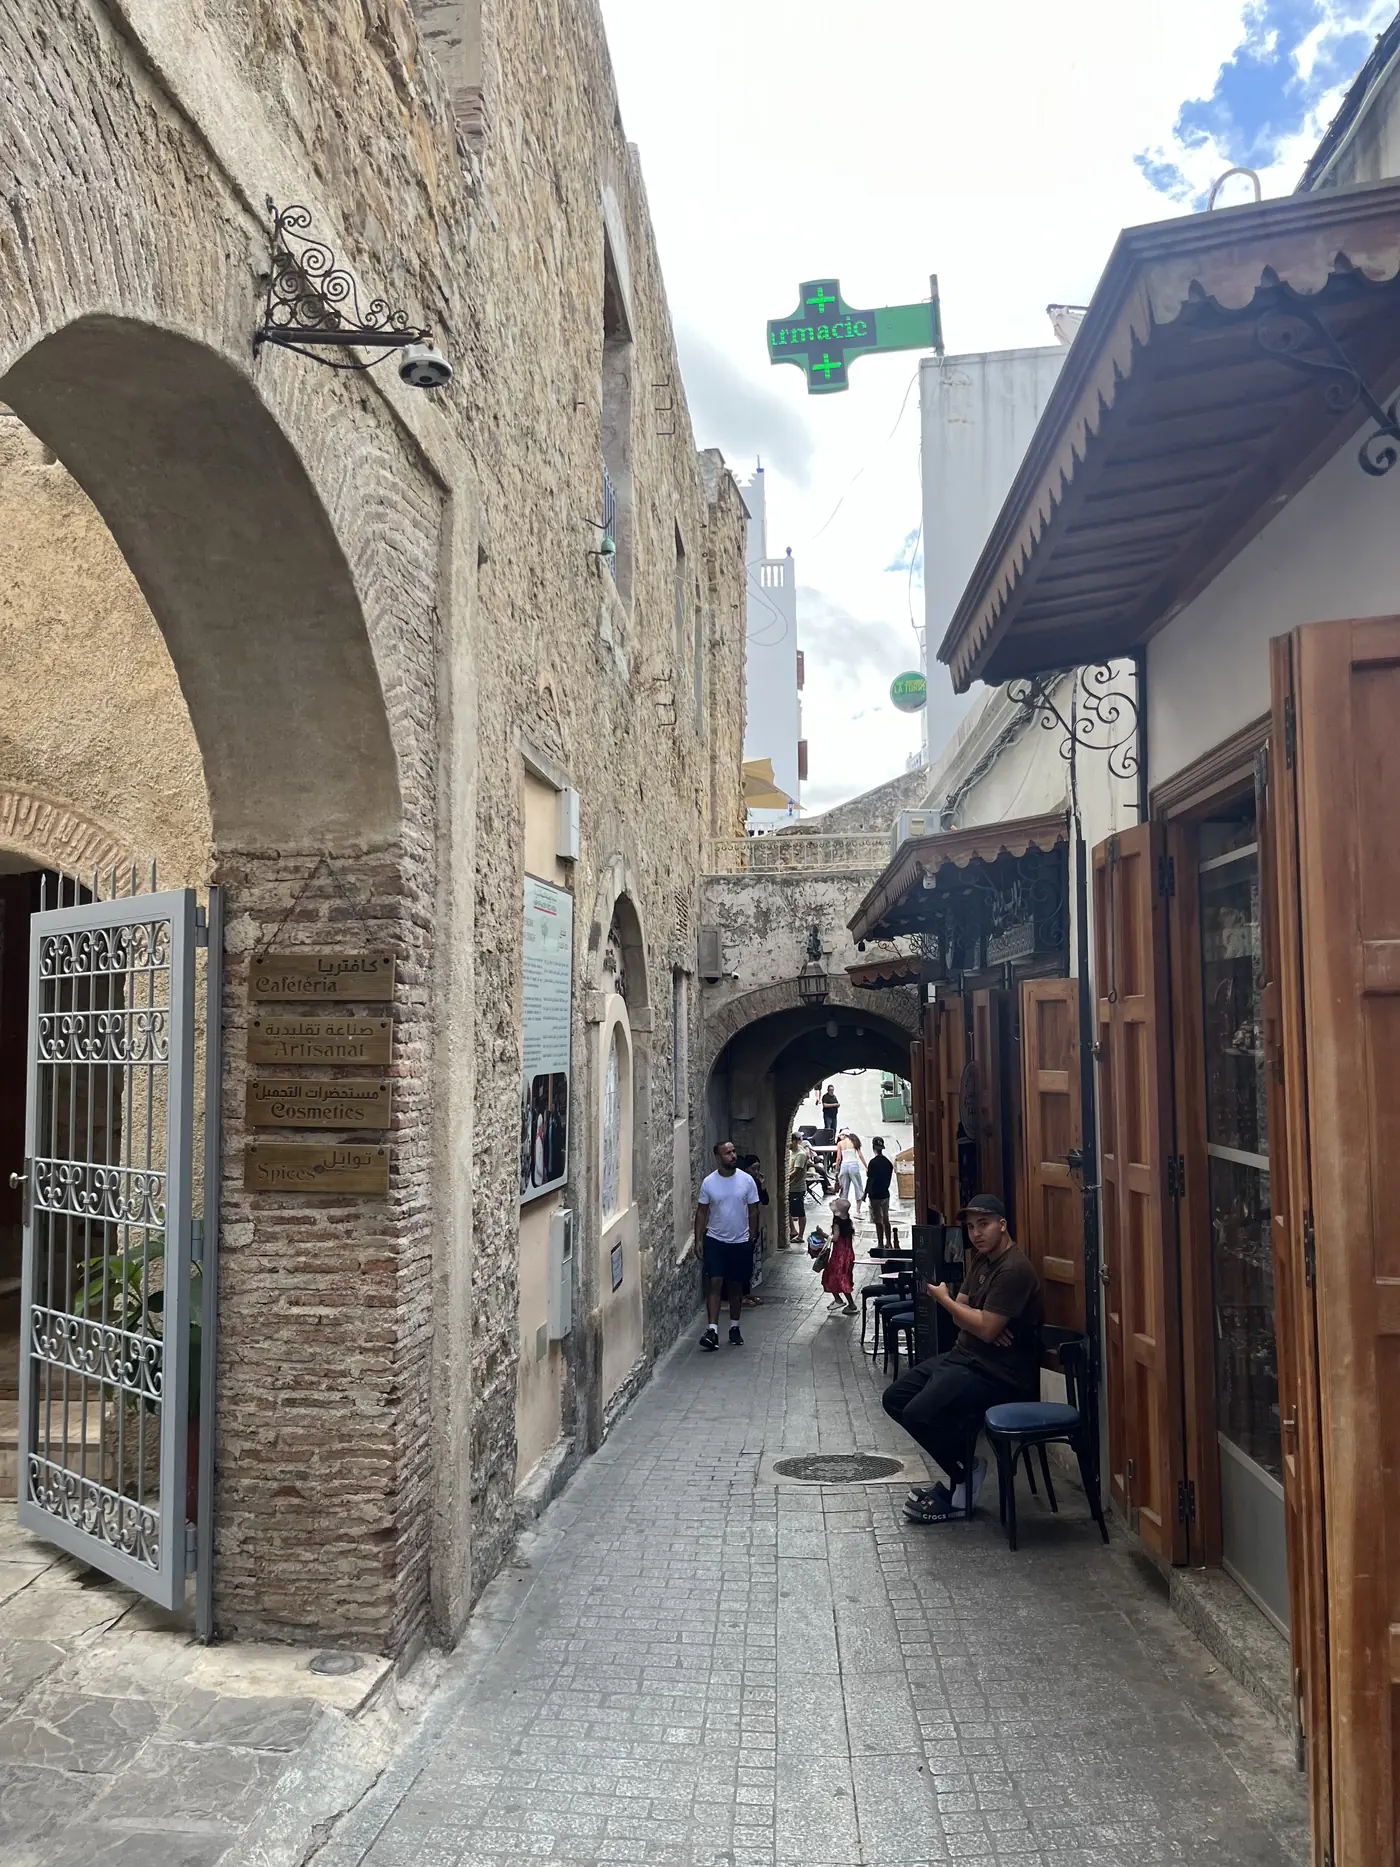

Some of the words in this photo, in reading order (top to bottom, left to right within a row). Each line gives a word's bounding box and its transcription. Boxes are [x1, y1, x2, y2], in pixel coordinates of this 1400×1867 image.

[317, 958, 378, 977] كافتريا
[255, 976, 338, 993] Cafétéria
[265, 1023, 321, 1039] تقليدية
[325, 1023, 374, 1037] صناعة
[274, 1040, 365, 1057] Artisanat
[255, 1085, 302, 1101] التجميل
[305, 1086, 379, 1102] مستحضرات
[271, 1102, 365, 1121] Cosmetics
[323, 1151, 372, 1170] توابل
[257, 1162, 317, 1183] Spices
